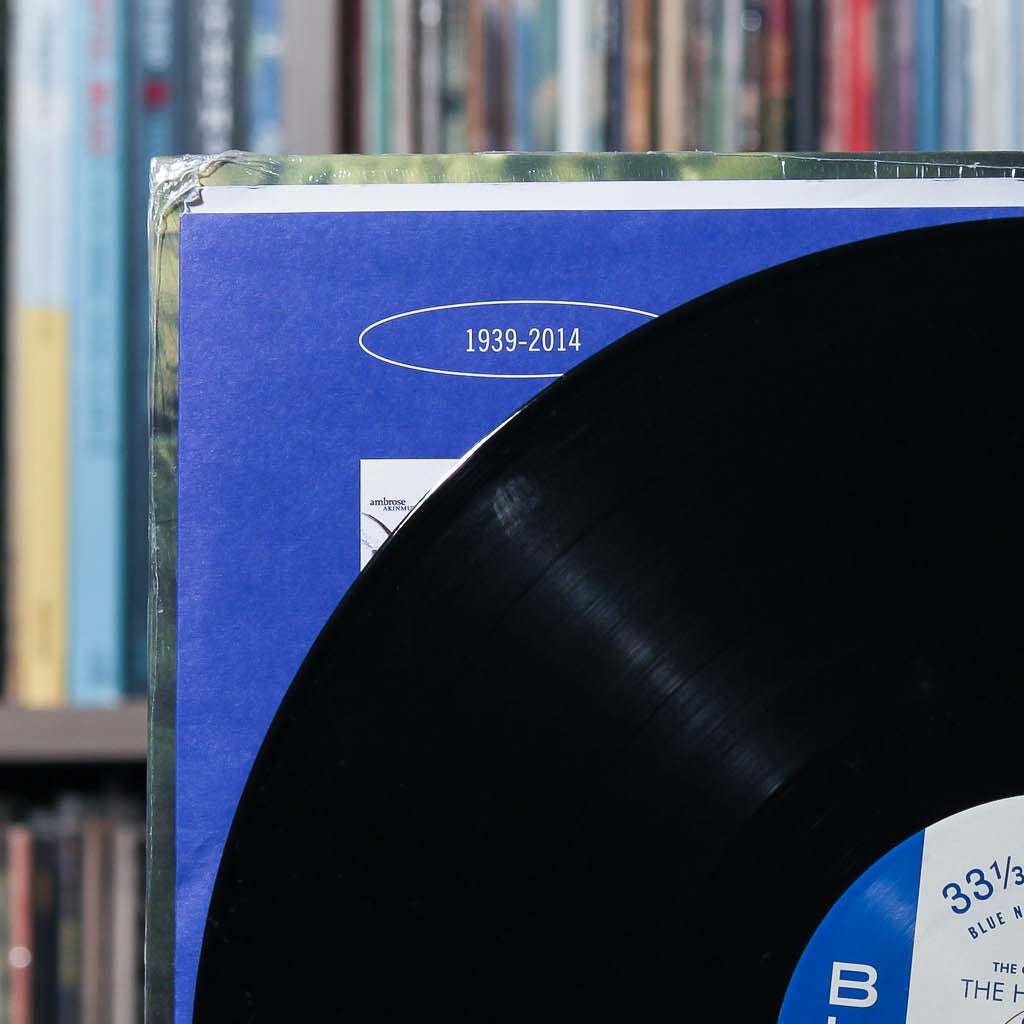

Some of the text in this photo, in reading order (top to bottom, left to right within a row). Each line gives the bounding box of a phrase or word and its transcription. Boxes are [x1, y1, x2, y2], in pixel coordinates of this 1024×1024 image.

[466, 327, 581, 352] 1939-2014
[369, 497, 407, 506] ambrose
[967, 912, 1006, 939] BLUE
[992, 961, 1019, 976] THE
[961, 979, 1005, 1002] THE
